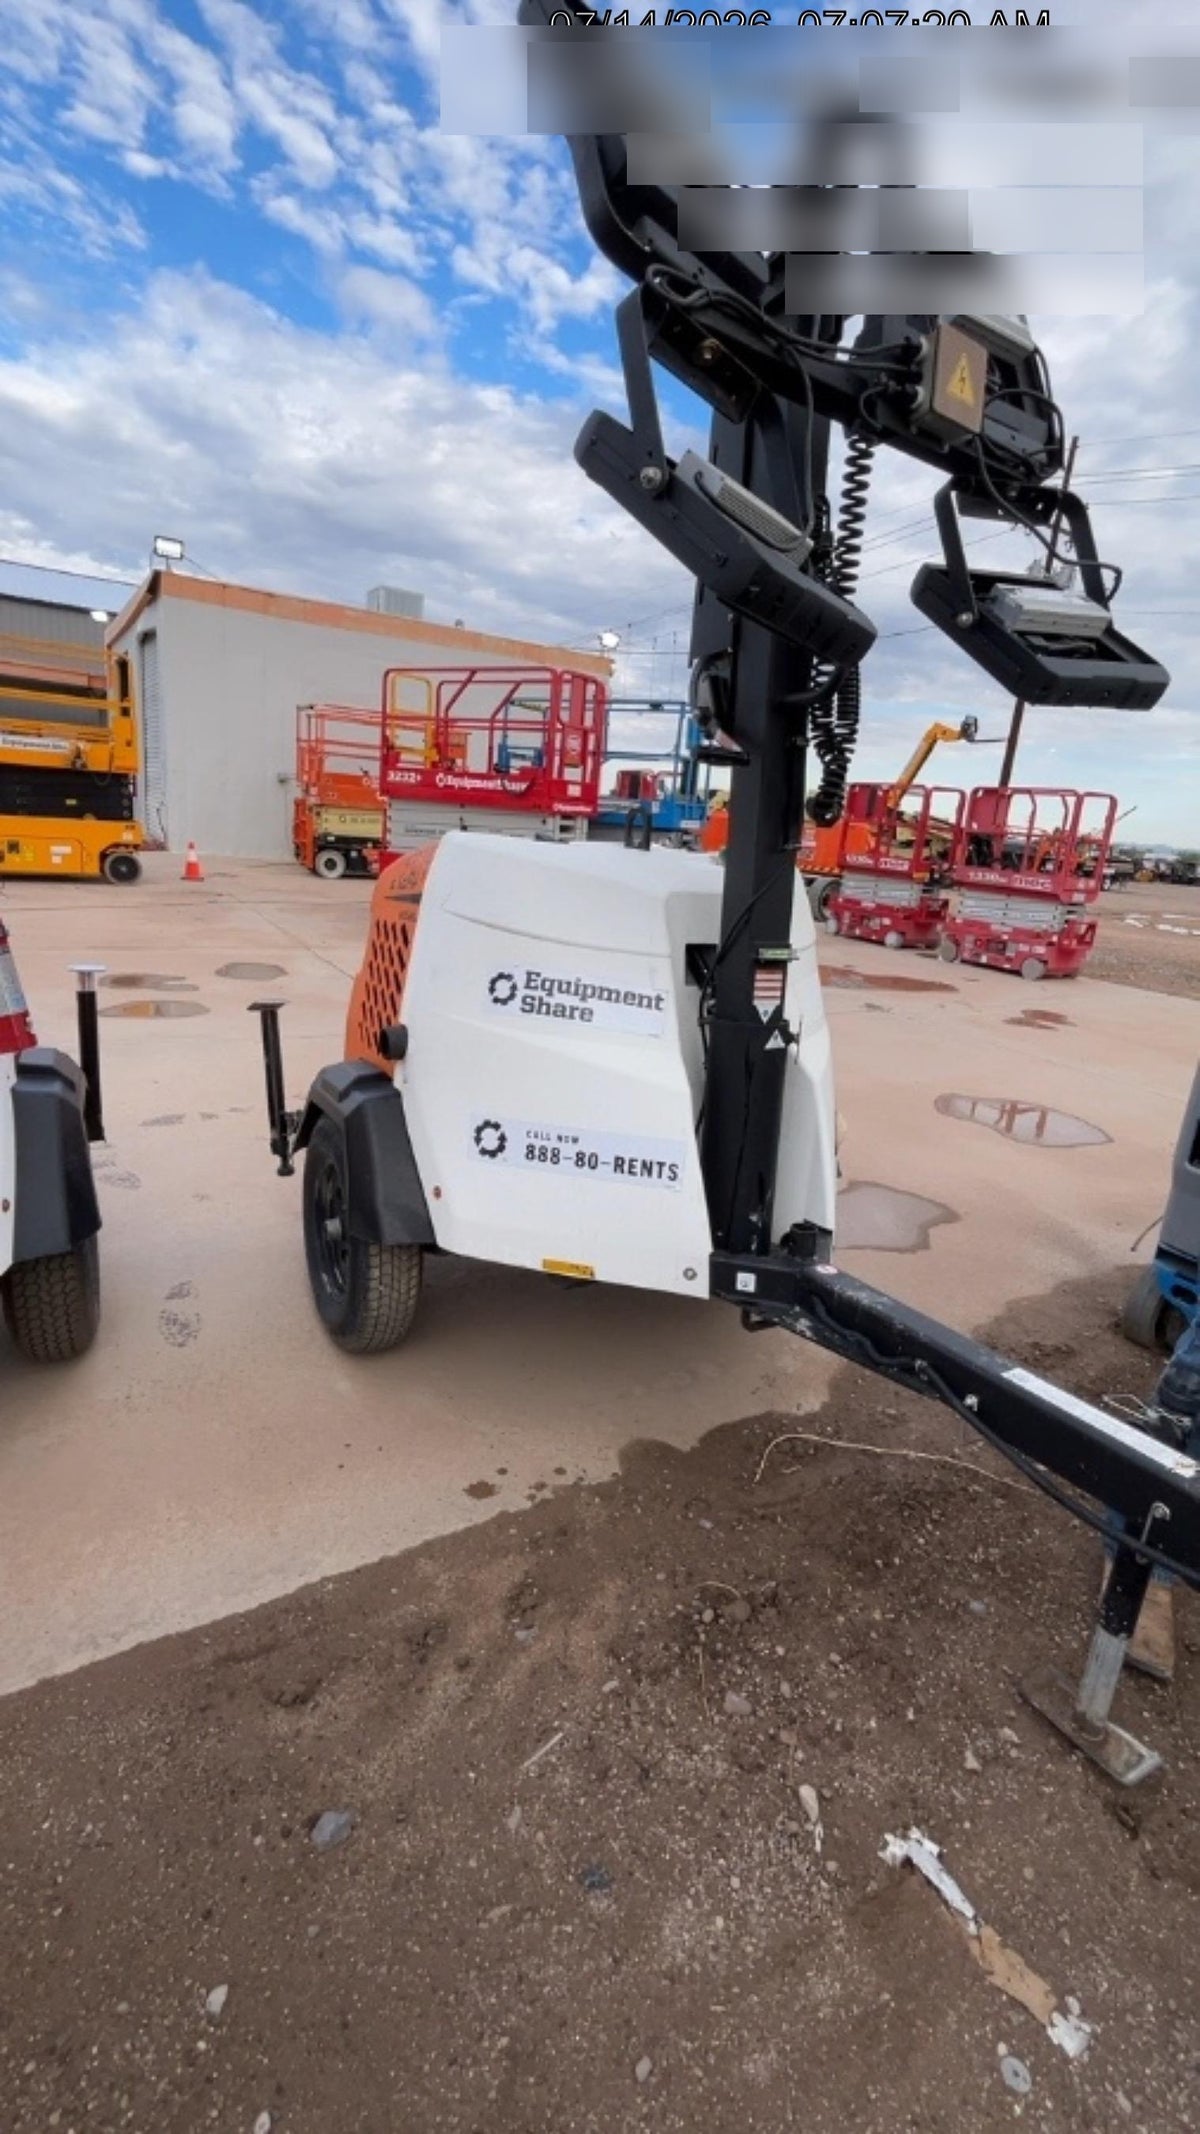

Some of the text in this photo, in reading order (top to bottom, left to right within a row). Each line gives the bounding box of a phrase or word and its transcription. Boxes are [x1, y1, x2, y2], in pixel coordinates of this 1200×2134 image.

[523, 970, 665, 1011] Equipment
[520, 994, 594, 1022] Share
[557, 1134, 579, 1144] NOW
[525, 1143, 680, 1182] 888-80-RENTS
